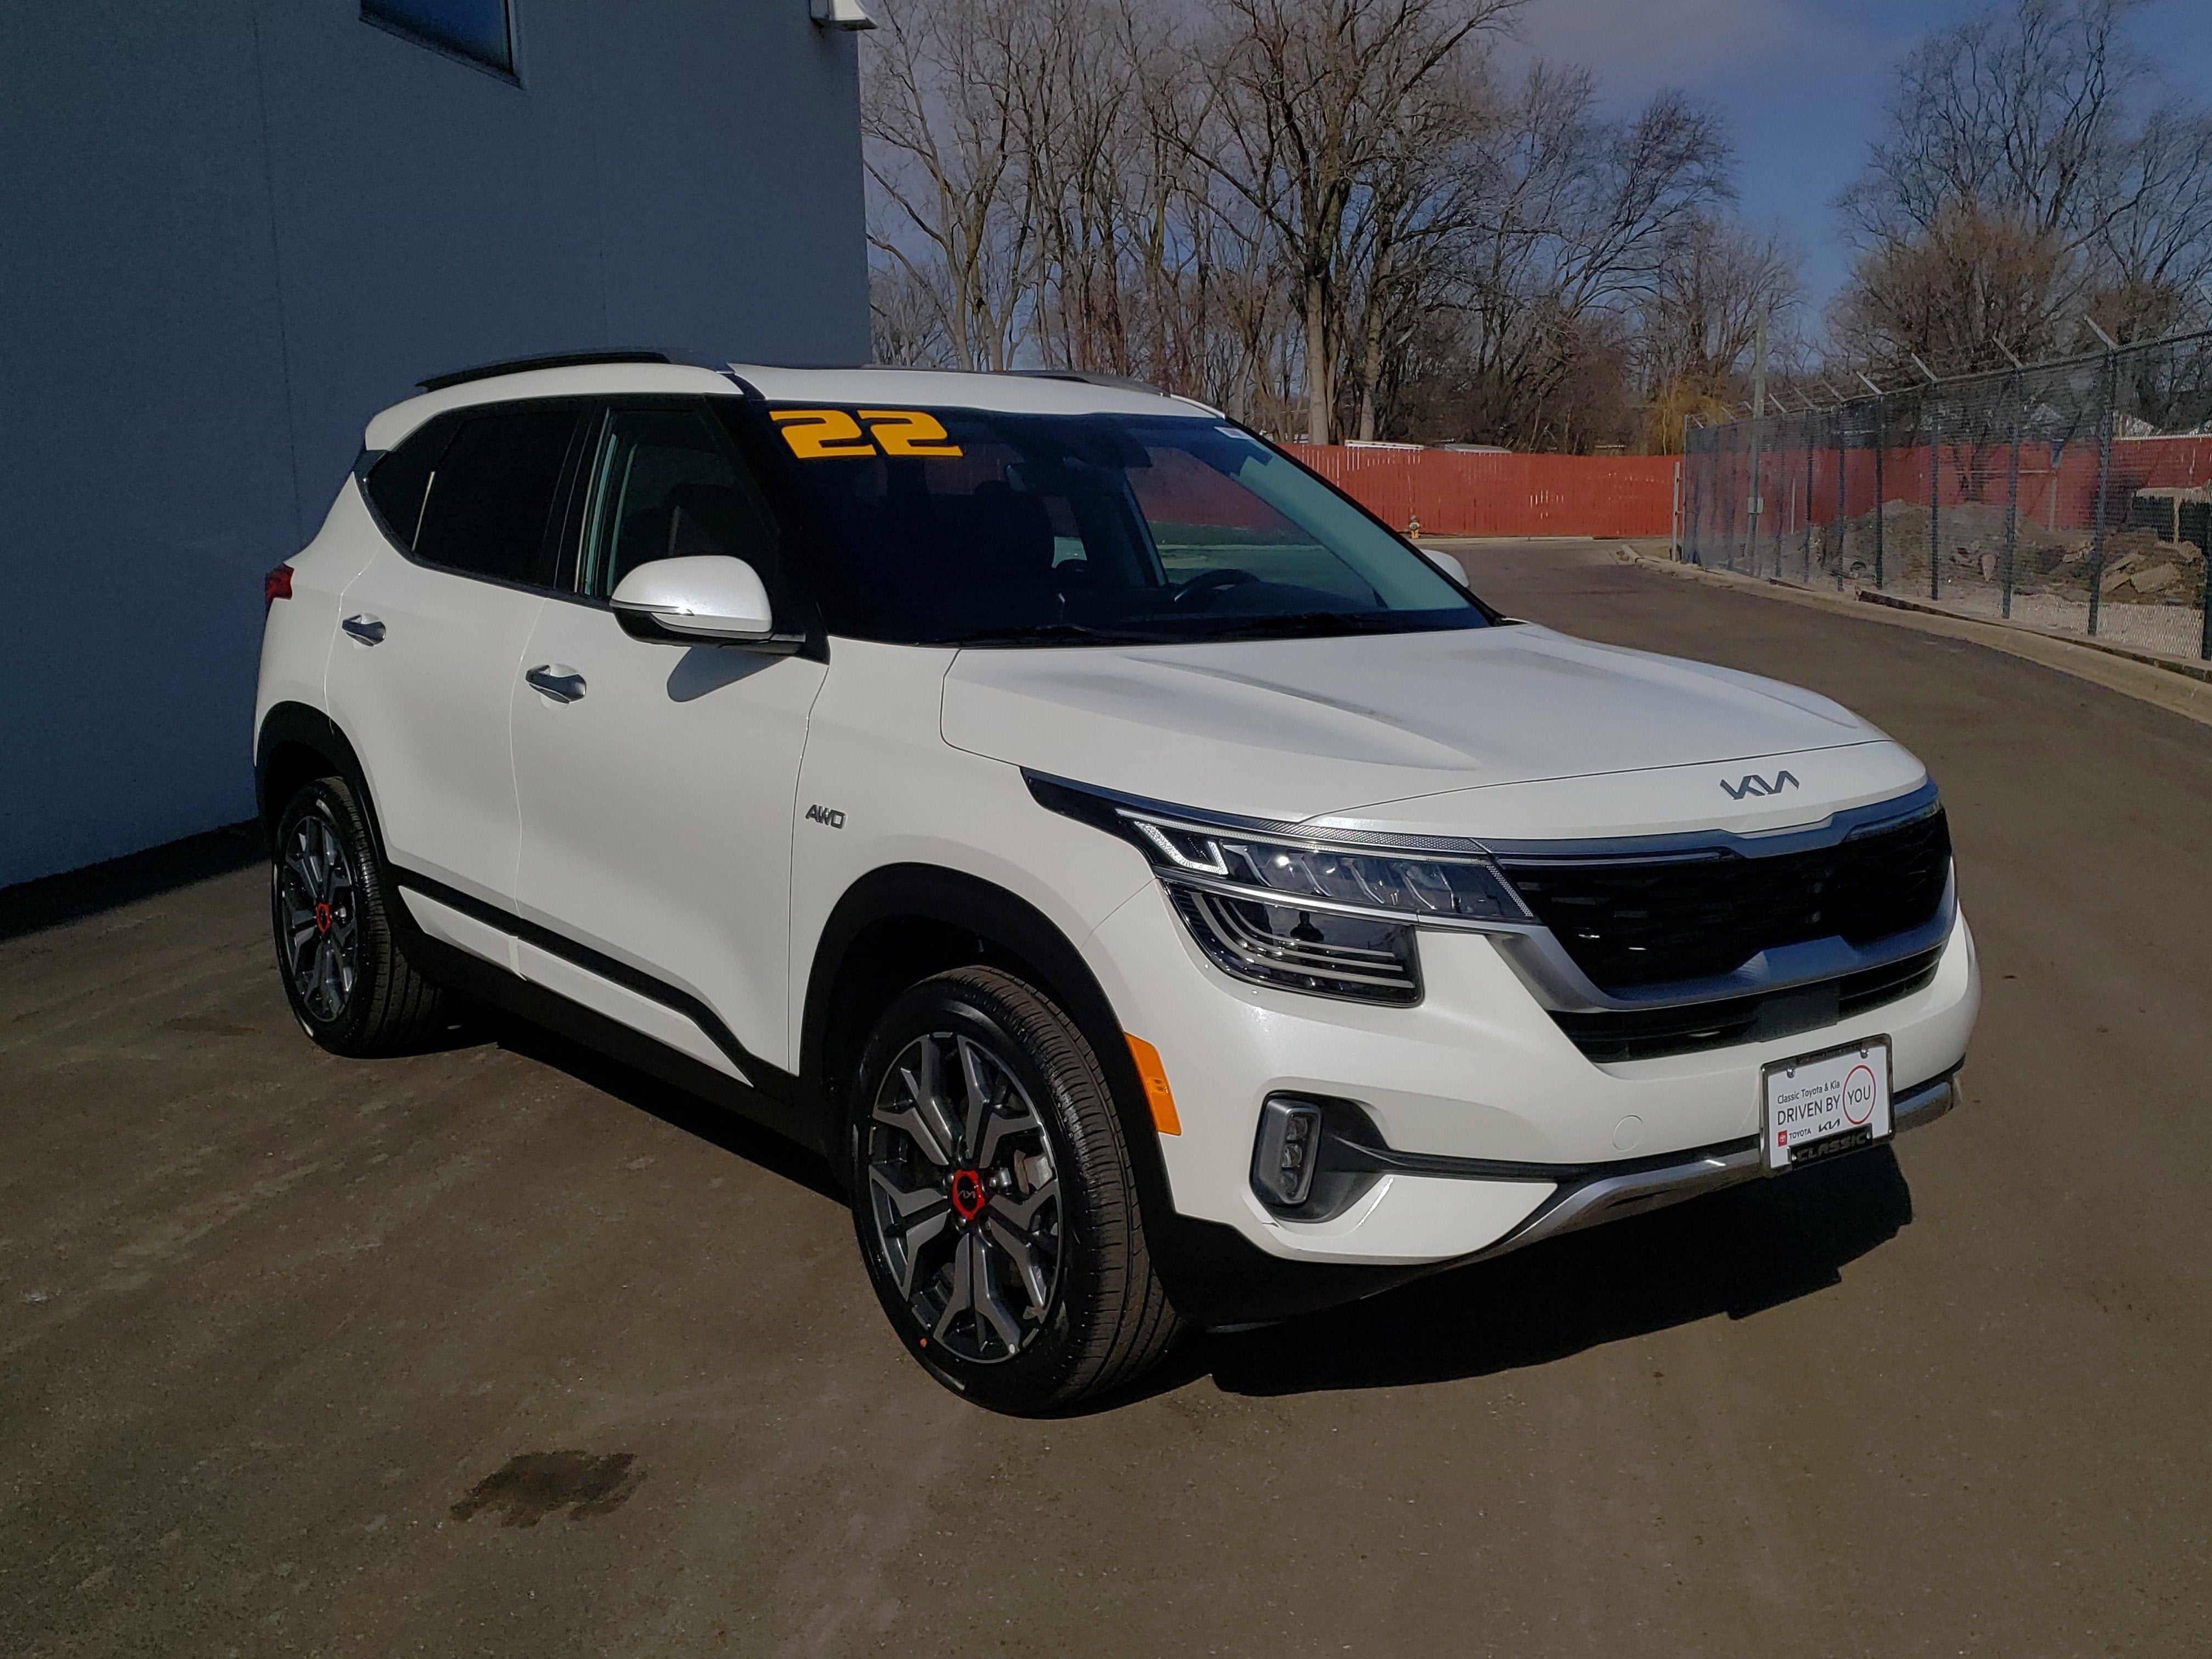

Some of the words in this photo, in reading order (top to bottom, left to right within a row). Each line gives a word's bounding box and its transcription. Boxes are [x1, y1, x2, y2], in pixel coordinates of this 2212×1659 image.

[769, 409, 963, 459] 22
[1720, 770, 1799, 800] KIA
[805, 804, 846, 830] AWD
[1777, 1091, 1799, 1104] Classic
[1801, 1086, 1822, 1098] Toyota
[1824, 1082, 1829, 1092] &
[1830, 1080, 1840, 1090] Kia
[1778, 1099, 1822, 1126] DRIVEN
[1826, 1094, 1841, 1112] BY
[1847, 1084, 1871, 1105] YOU
[1789, 1128, 1812, 1140] TOYOTA
[1797, 1130, 1867, 1162] CLASSIC
